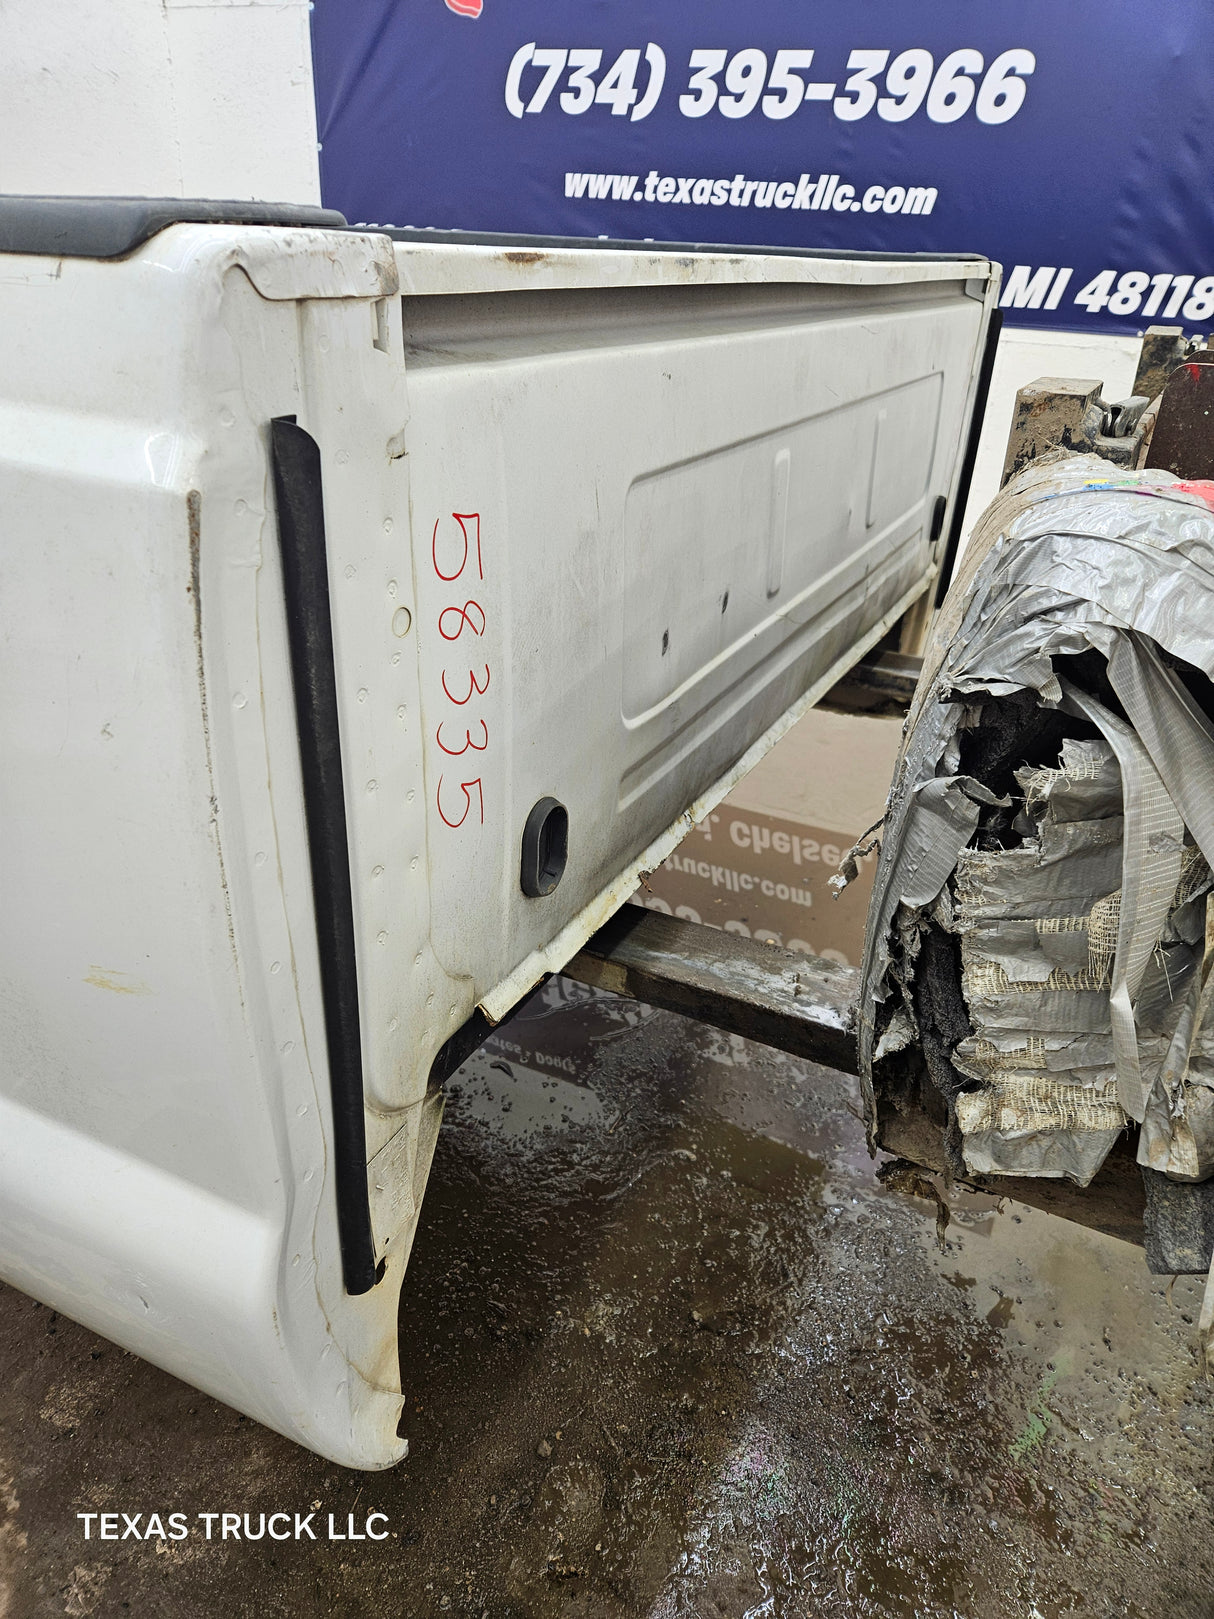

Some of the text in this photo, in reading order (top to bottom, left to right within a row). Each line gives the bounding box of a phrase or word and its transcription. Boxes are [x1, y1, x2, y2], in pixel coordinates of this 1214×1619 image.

[505, 42, 1036, 125] (734) 395-3966
[565, 171, 937, 216] www.texastruckllc.com
[999, 265, 1214, 321] MI 48118
[432, 512, 490, 828] 58335
